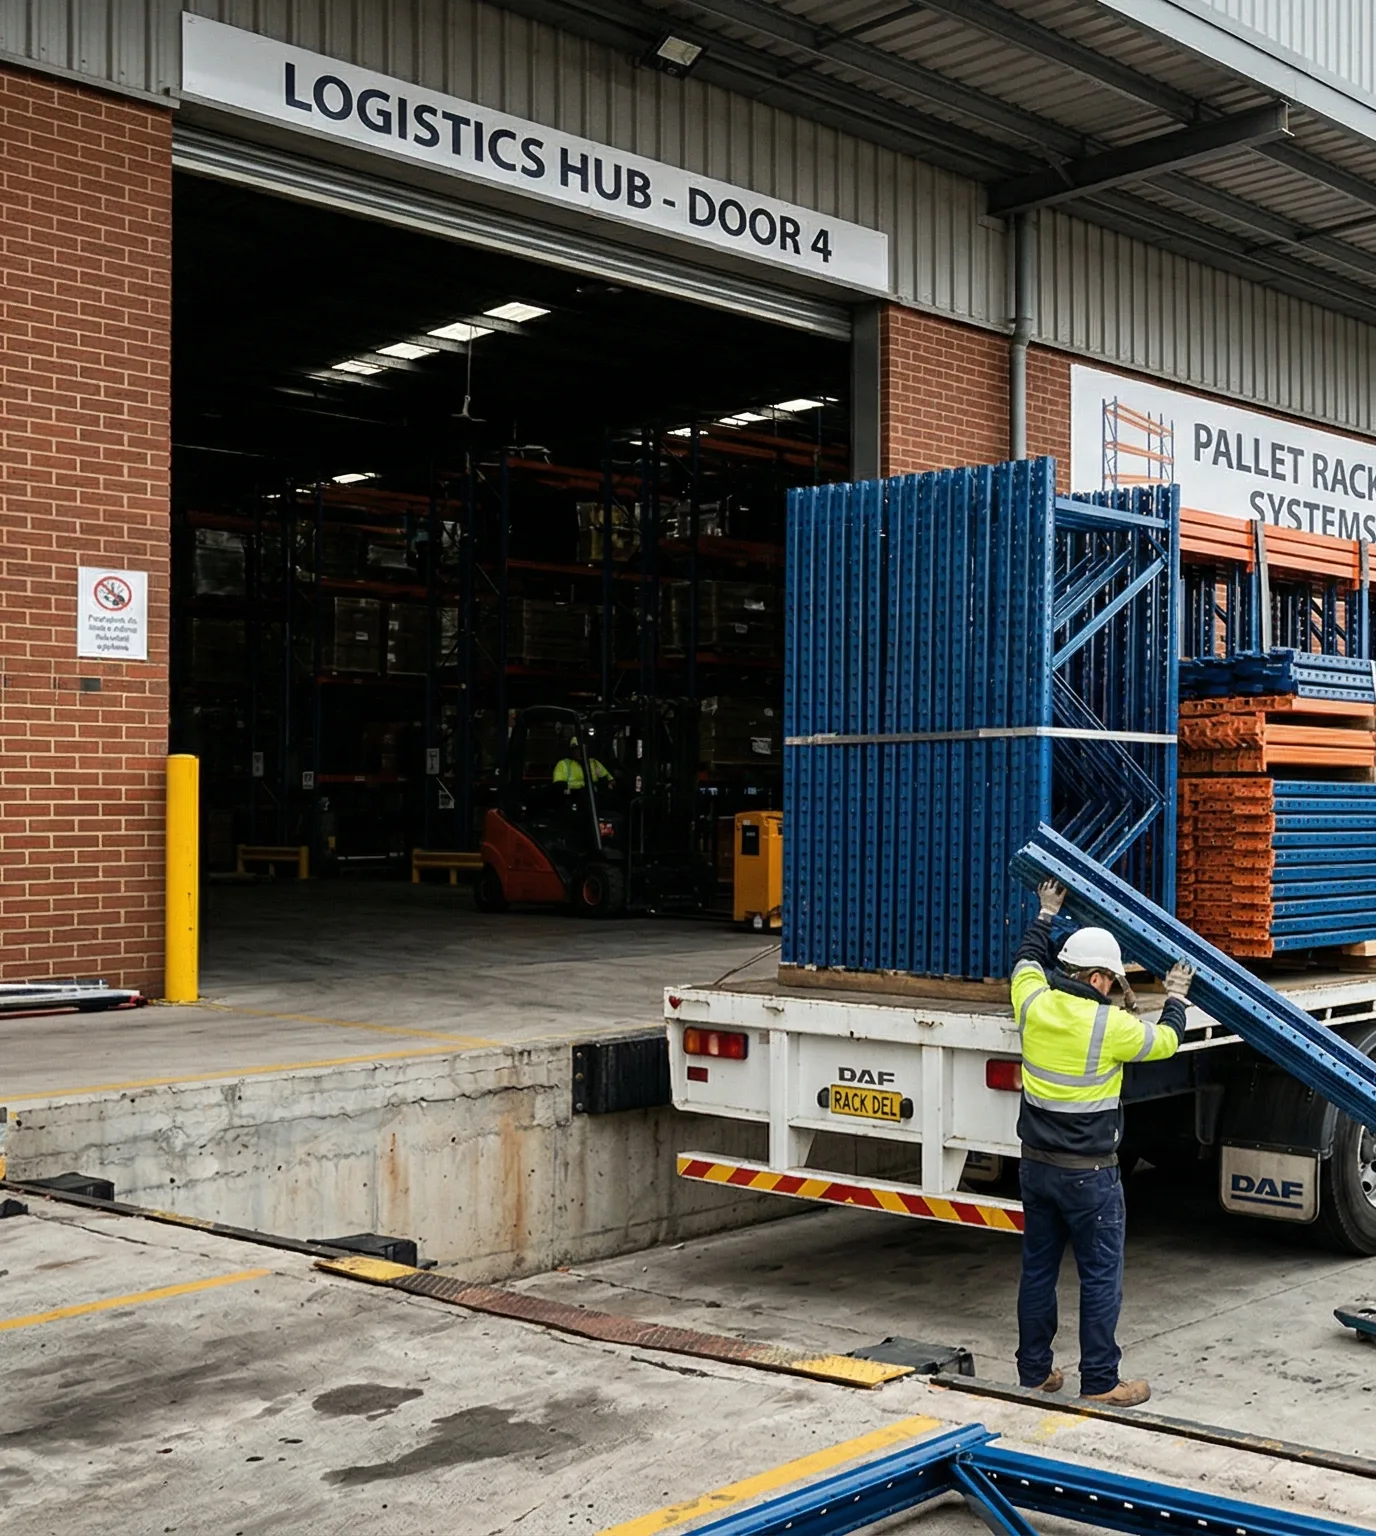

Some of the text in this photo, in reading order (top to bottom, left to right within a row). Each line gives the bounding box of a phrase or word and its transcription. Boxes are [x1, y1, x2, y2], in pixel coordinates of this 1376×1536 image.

[284, 62, 547, 180] LOGISTICS
[559, 146, 653, 211] HUB
[688, 187, 802, 256] DOOR
[810, 228, 834, 264] 4
[1193, 422, 1305, 486] PALLET
[838, 1066, 895, 1086] DAF
[834, 1090, 898, 1118] RACK DEL
[1231, 1173, 1304, 1199] DAF
